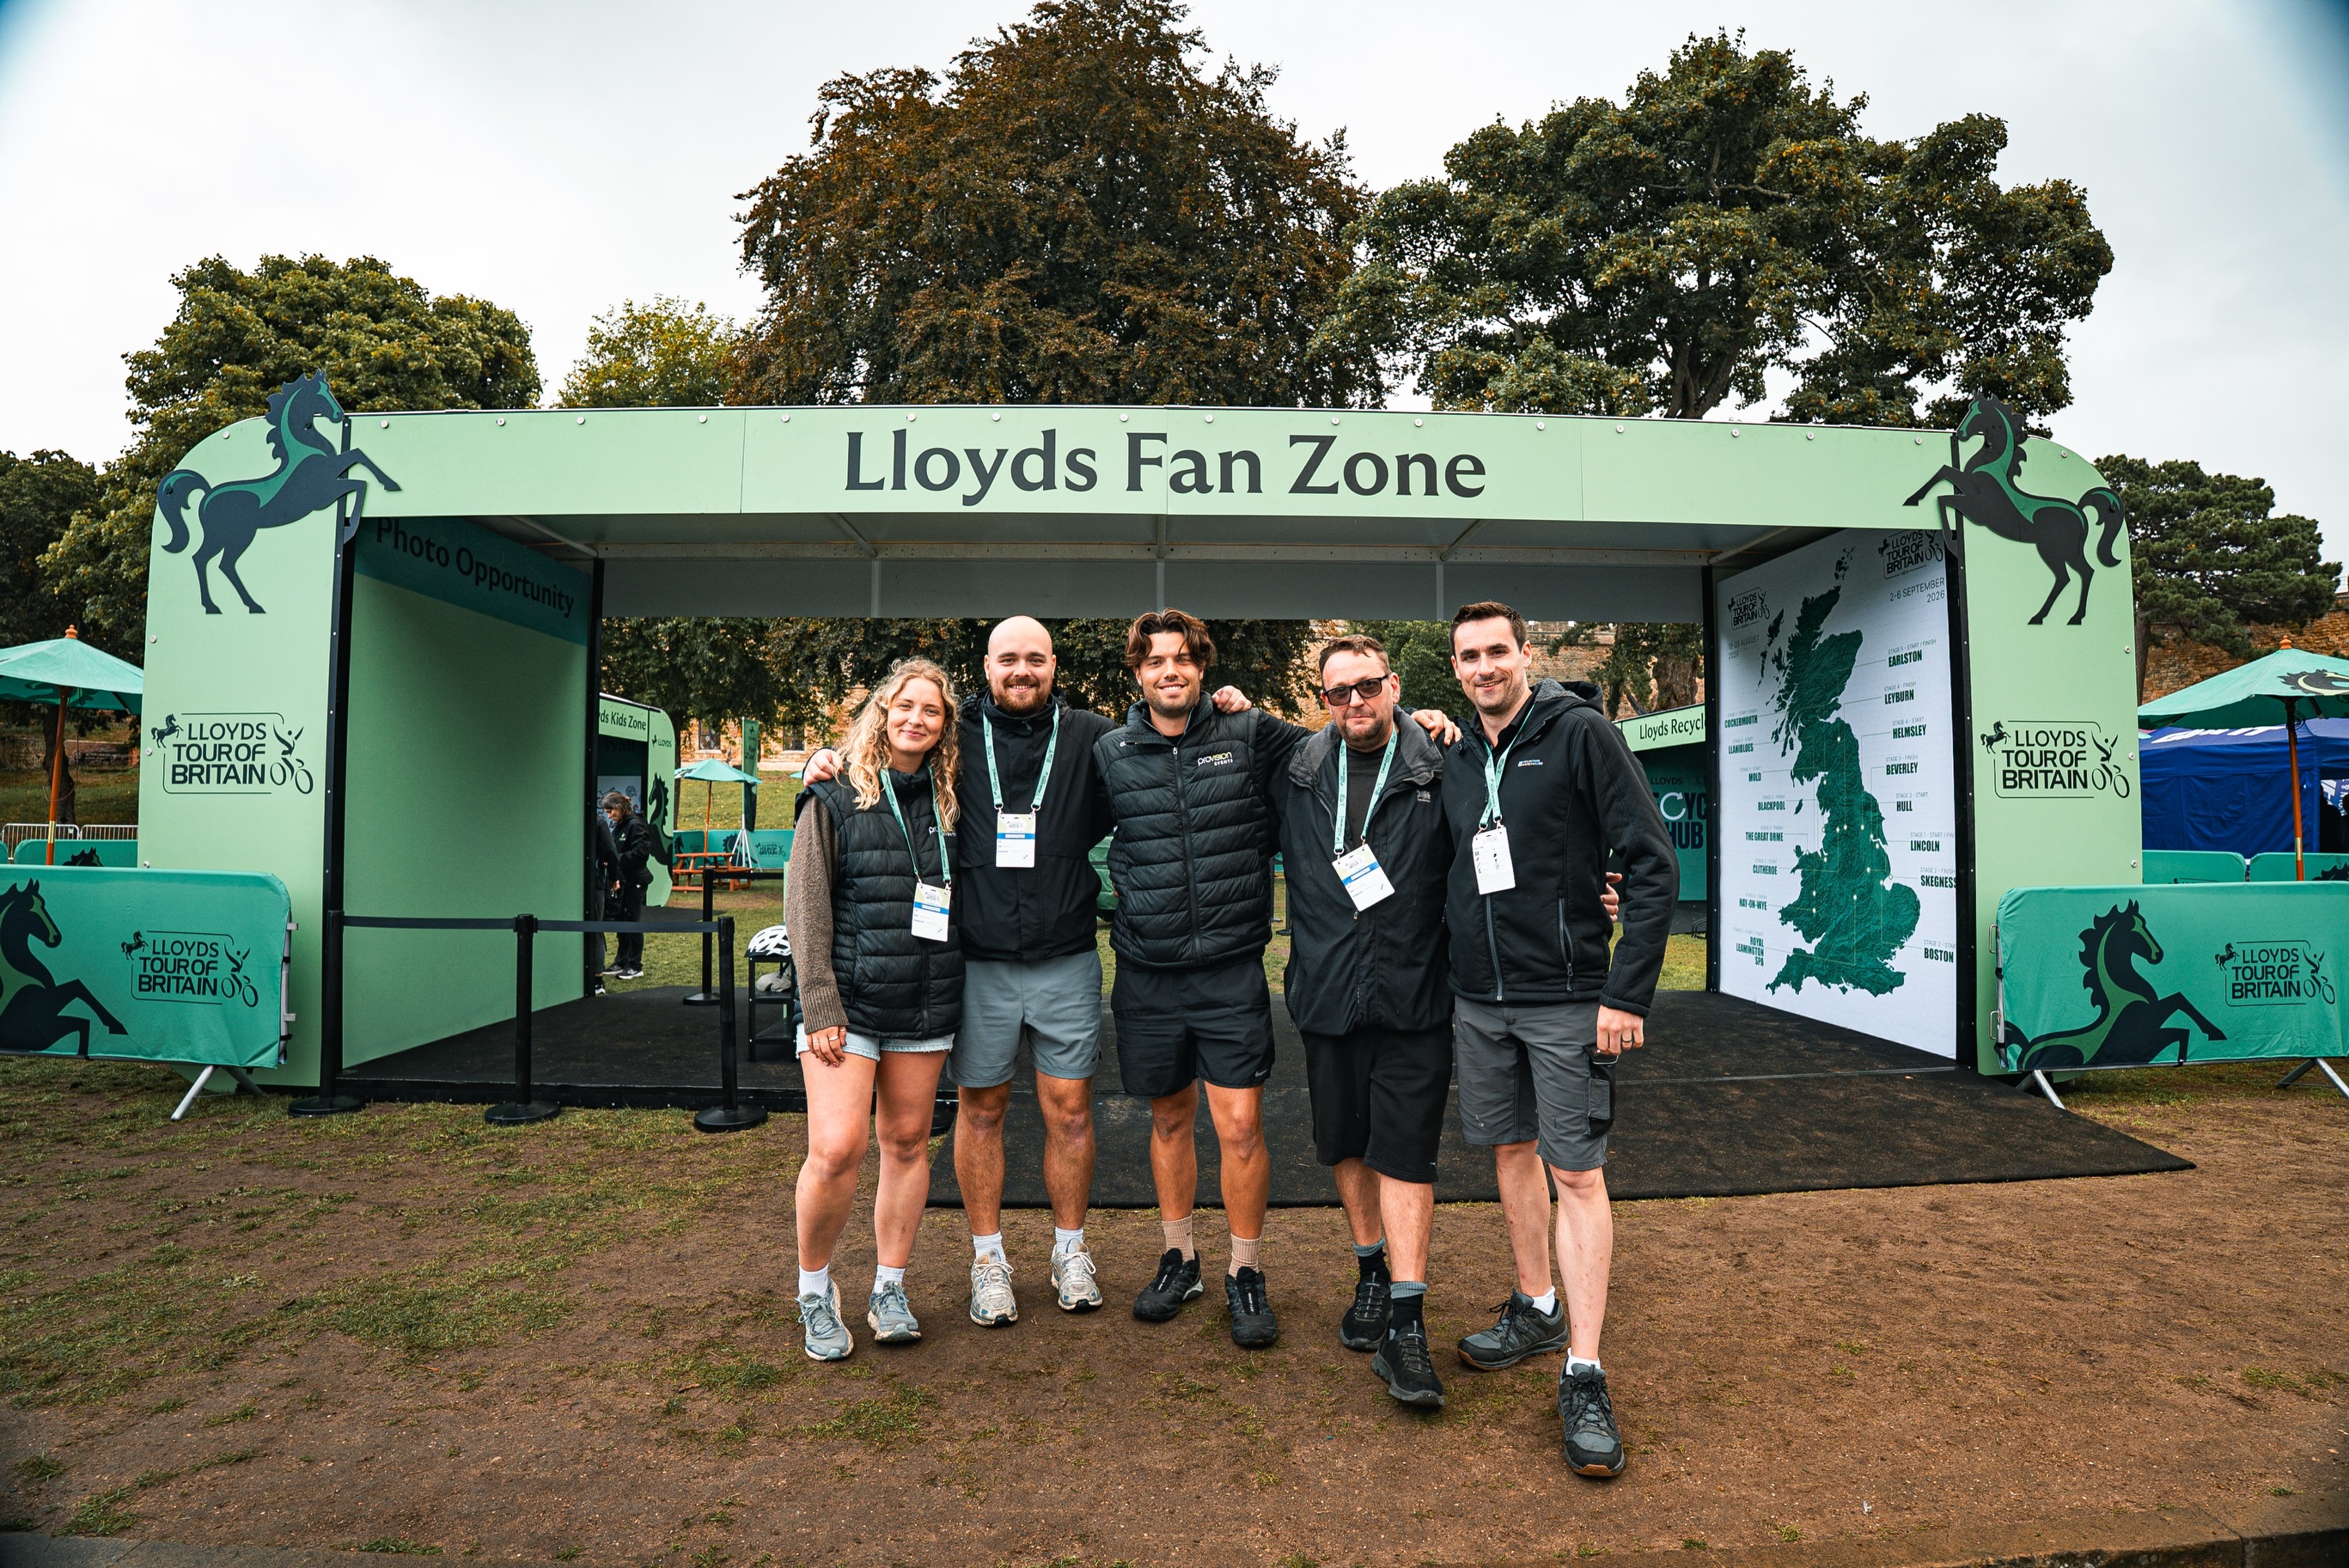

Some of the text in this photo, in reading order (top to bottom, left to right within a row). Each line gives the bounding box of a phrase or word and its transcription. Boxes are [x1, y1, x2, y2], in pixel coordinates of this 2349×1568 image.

[845, 428, 1486, 507] Lloyds Fan Zone
[1891, 529, 1924, 550] LLOYDS
[1886, 540, 1924, 562] TOUR OF
[376, 517, 575, 619] Photo Opportunity
[1886, 551, 1925, 575] BRITAIN
[1890, 577, 1945, 601] 2-6 SEPTEMBER
[1926, 589, 1945, 602] 2026
[1736, 592, 1757, 607] LLOYDS
[1733, 601, 1758, 617] TOUR OF
[1733, 609, 1758, 626] BRITAIN
[1741, 634, 1760, 646] AUGUST
[1923, 638, 1937, 647] FINISH
[1888, 650, 1922, 668] EARLSTON
[1884, 689, 1914, 705] LEYBURN
[610, 711, 627, 727] Kids
[627, 715, 647, 731] Zone
[1639, 712, 1706, 741] Lloyds Recycl
[1724, 714, 1759, 729] COCKERMOUTH
[188, 723, 267, 741] LLOYDS
[1893, 723, 1927, 740] HELMSLEY
[2015, 730, 2087, 747] LLOYDS
[657, 739, 672, 748] LLOYDS
[1728, 743, 1754, 754] LLANIDLOES
[173, 743, 266, 762] TOUR OF
[1197, 752, 1233, 767] provision
[2001, 750, 2087, 767] TOUR OF
[1213, 758, 1234, 766] EVENTS
[1886, 761, 1919, 776] BEVERLEY
[172, 764, 265, 784] BRITAIN
[1650, 777, 1683, 785] LLOYDS
[1748, 772, 1761, 782] MOLD
[2002, 770, 2088, 790] BRITAIN
[1757, 801, 1785, 811] BLACKPOOL
[1896, 800, 1913, 812] HULL
[1664, 821, 1704, 850] HUB
[1745, 832, 1784, 842] THE GREAT ORME
[1910, 839, 1940, 851] LINCOLN
[1753, 864, 1778, 876] CLITHEROE
[1739, 898, 1767, 911] HAY-ON-WYE
[152, 939, 219, 958] LLOYDS
[1736, 943, 1764, 957] LEAMINGTON
[1749, 937, 1764, 948] ROYAL
[1754, 956, 1764, 967] SPA
[1924, 947, 1954, 963] BOSTON
[2242, 948, 2299, 964] LLOYDS
[139, 956, 218, 976] TOUR OF
[2231, 964, 2300, 981] TOUR OF
[137, 974, 218, 996] BRITAIN
[2231, 980, 2301, 999] BRITAIN
